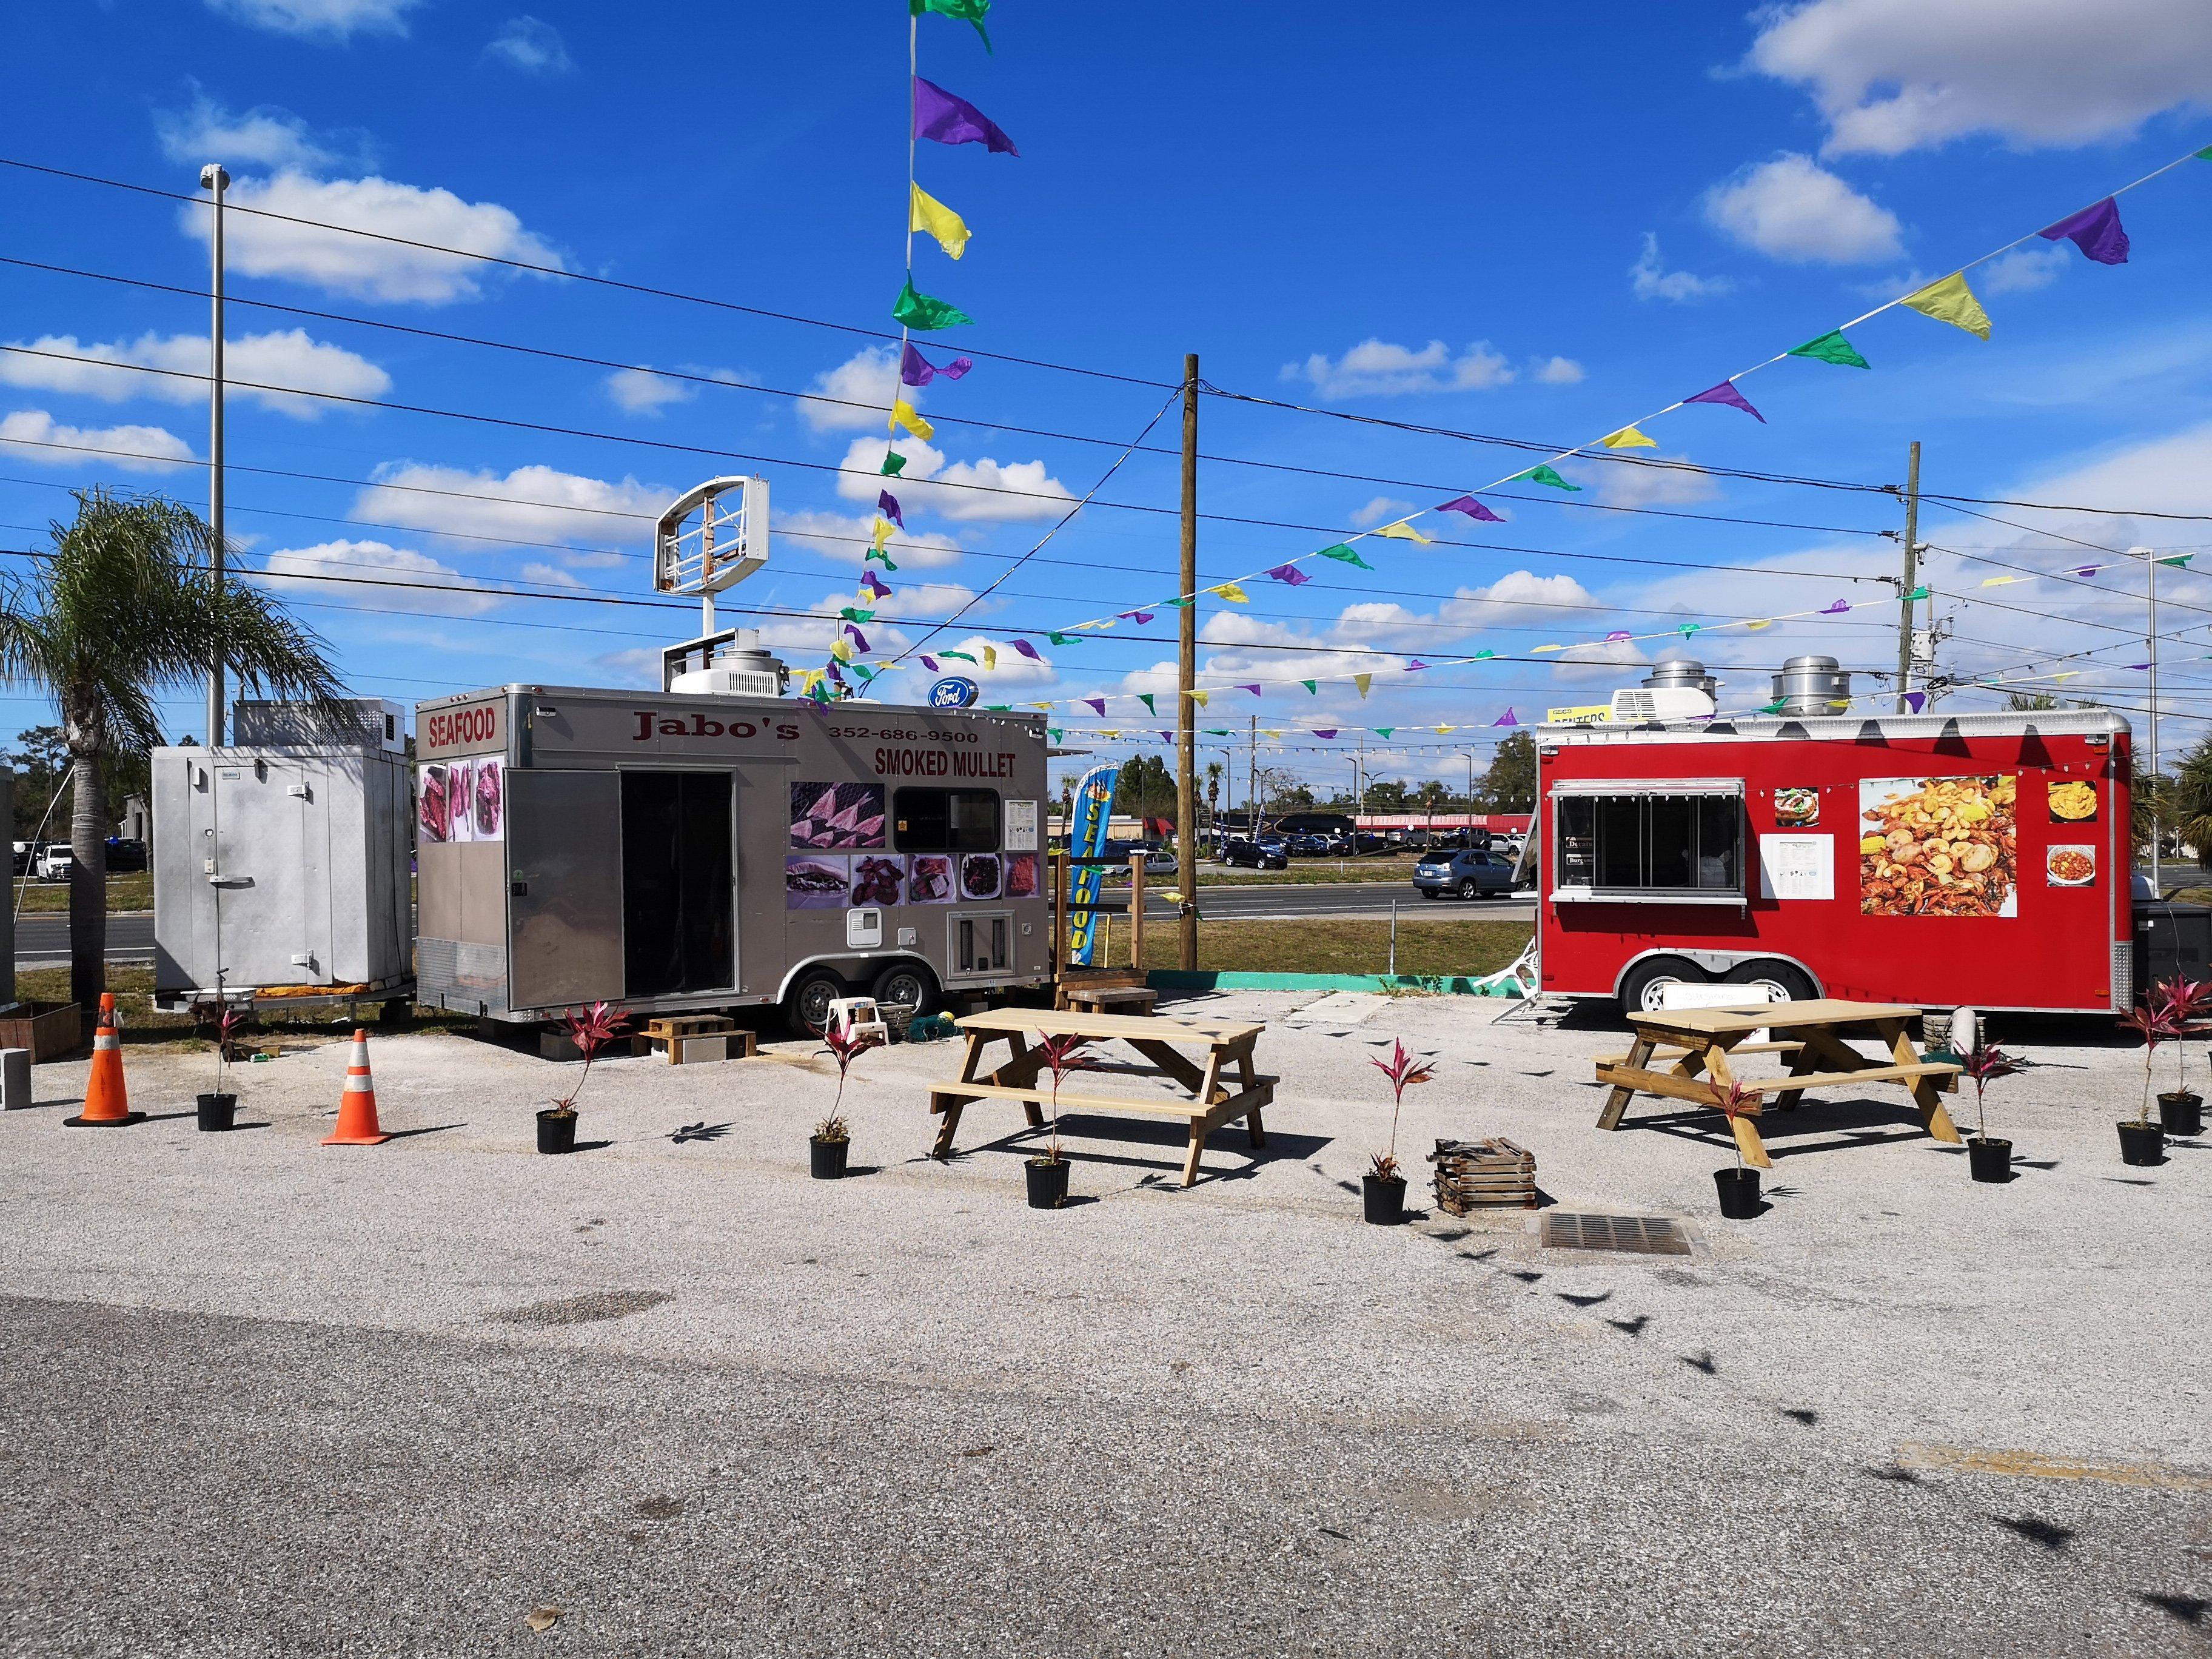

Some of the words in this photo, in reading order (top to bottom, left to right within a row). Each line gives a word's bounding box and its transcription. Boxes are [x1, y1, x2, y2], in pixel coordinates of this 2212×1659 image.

[935, 684, 960, 706] Ford
[429, 707, 495, 748] SEAFOOD
[632, 711, 800, 740] Jabo's
[828, 727, 979, 743] 352-686-9500
[875, 748, 948, 776] SMOKED
[953, 751, 1016, 778] MULLET
